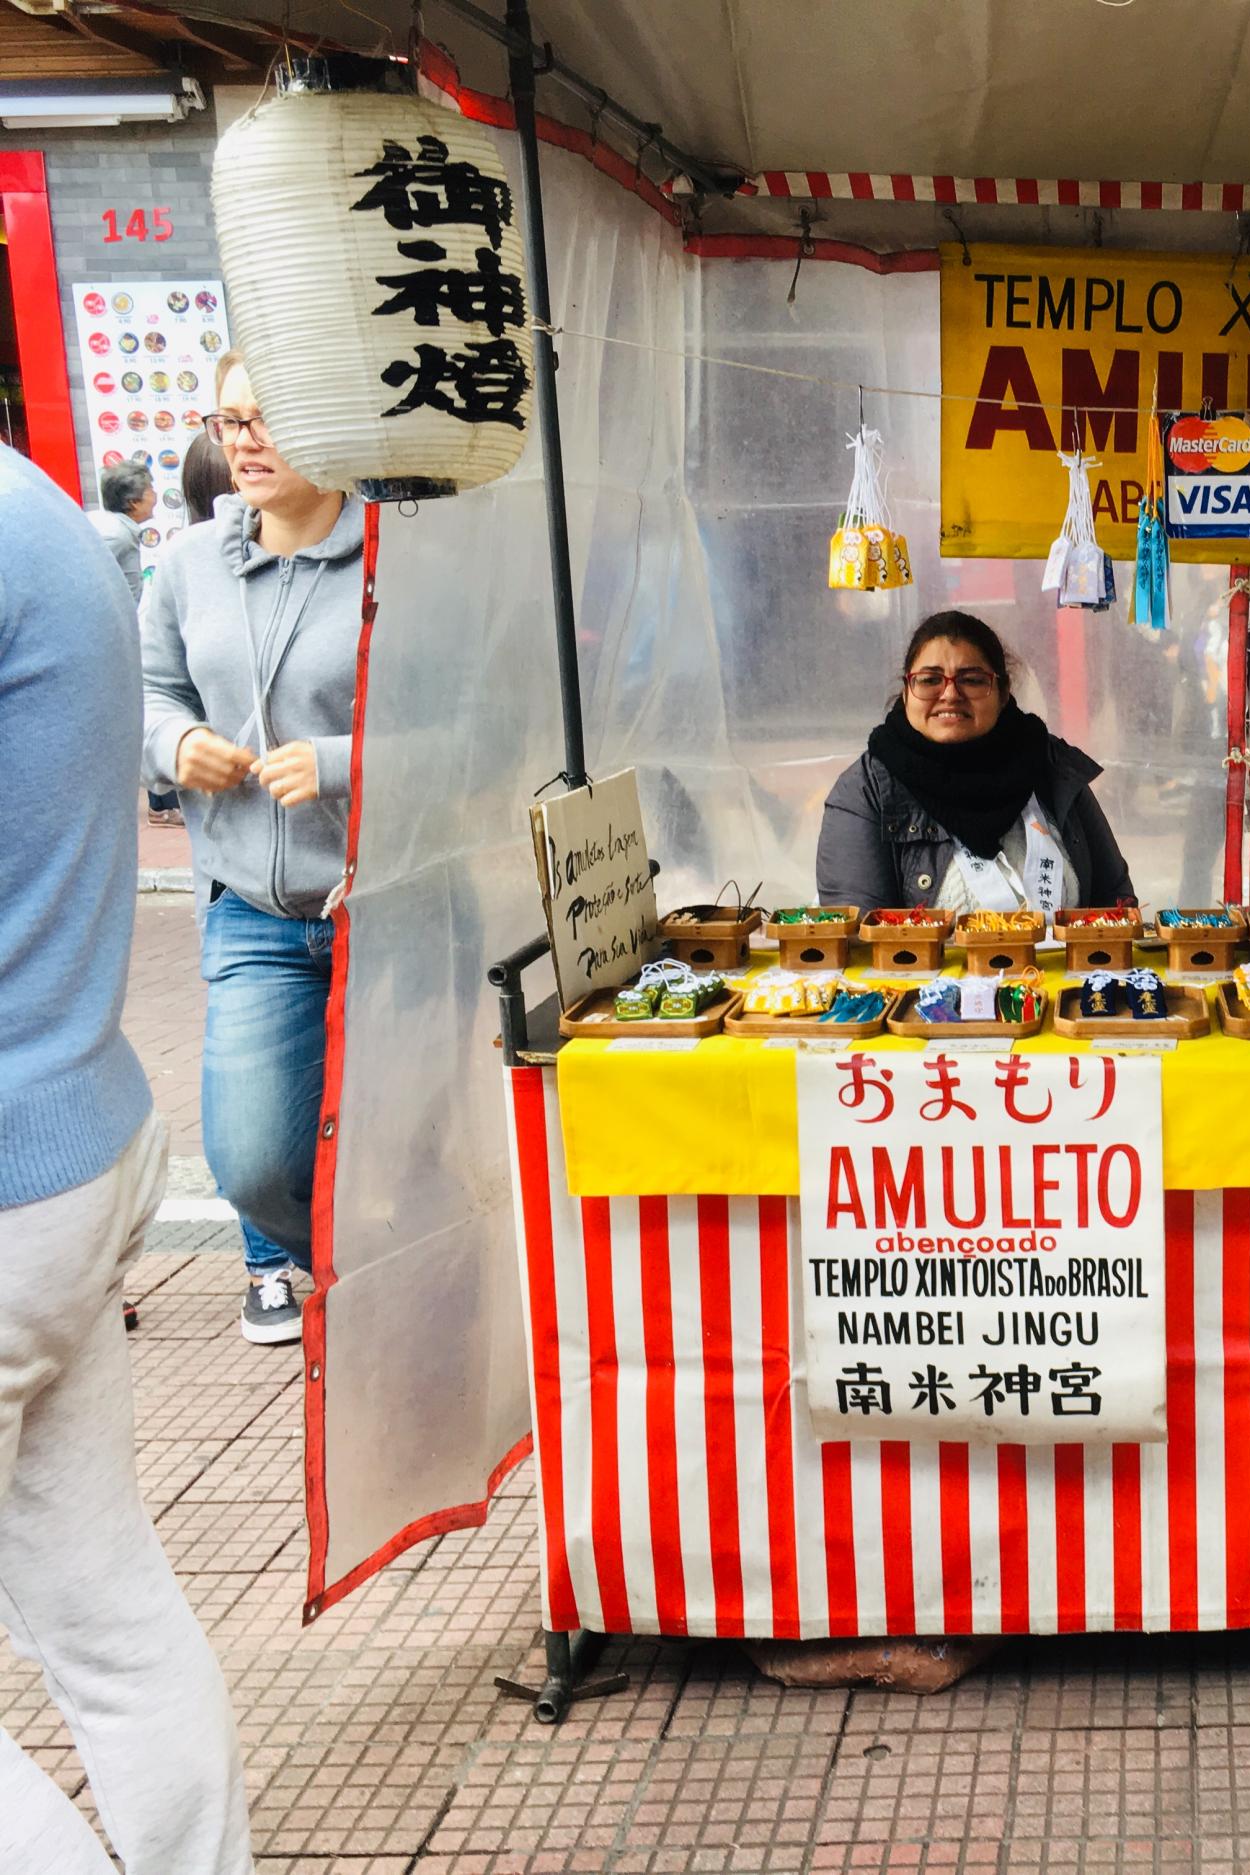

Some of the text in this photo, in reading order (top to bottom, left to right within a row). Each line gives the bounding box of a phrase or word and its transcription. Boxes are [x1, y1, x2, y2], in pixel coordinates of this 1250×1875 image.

[102, 208, 174, 243] 145
[974, 273, 1183, 335] TEMPLO
[836, 1053, 1117, 1124] おまもり
[826, 1143, 1142, 1230] AMULETO
[875, 1231, 1057, 1258] abençoado
[809, 1257, 908, 1298] TEMPLO
[916, 1257, 1044, 1298] XINTOISTA
[1068, 1257, 1148, 1298] BRASIL
[838, 1311, 1099, 1346] NAMBEI JINGU
[836, 1361, 1102, 1416] 南米神宮
